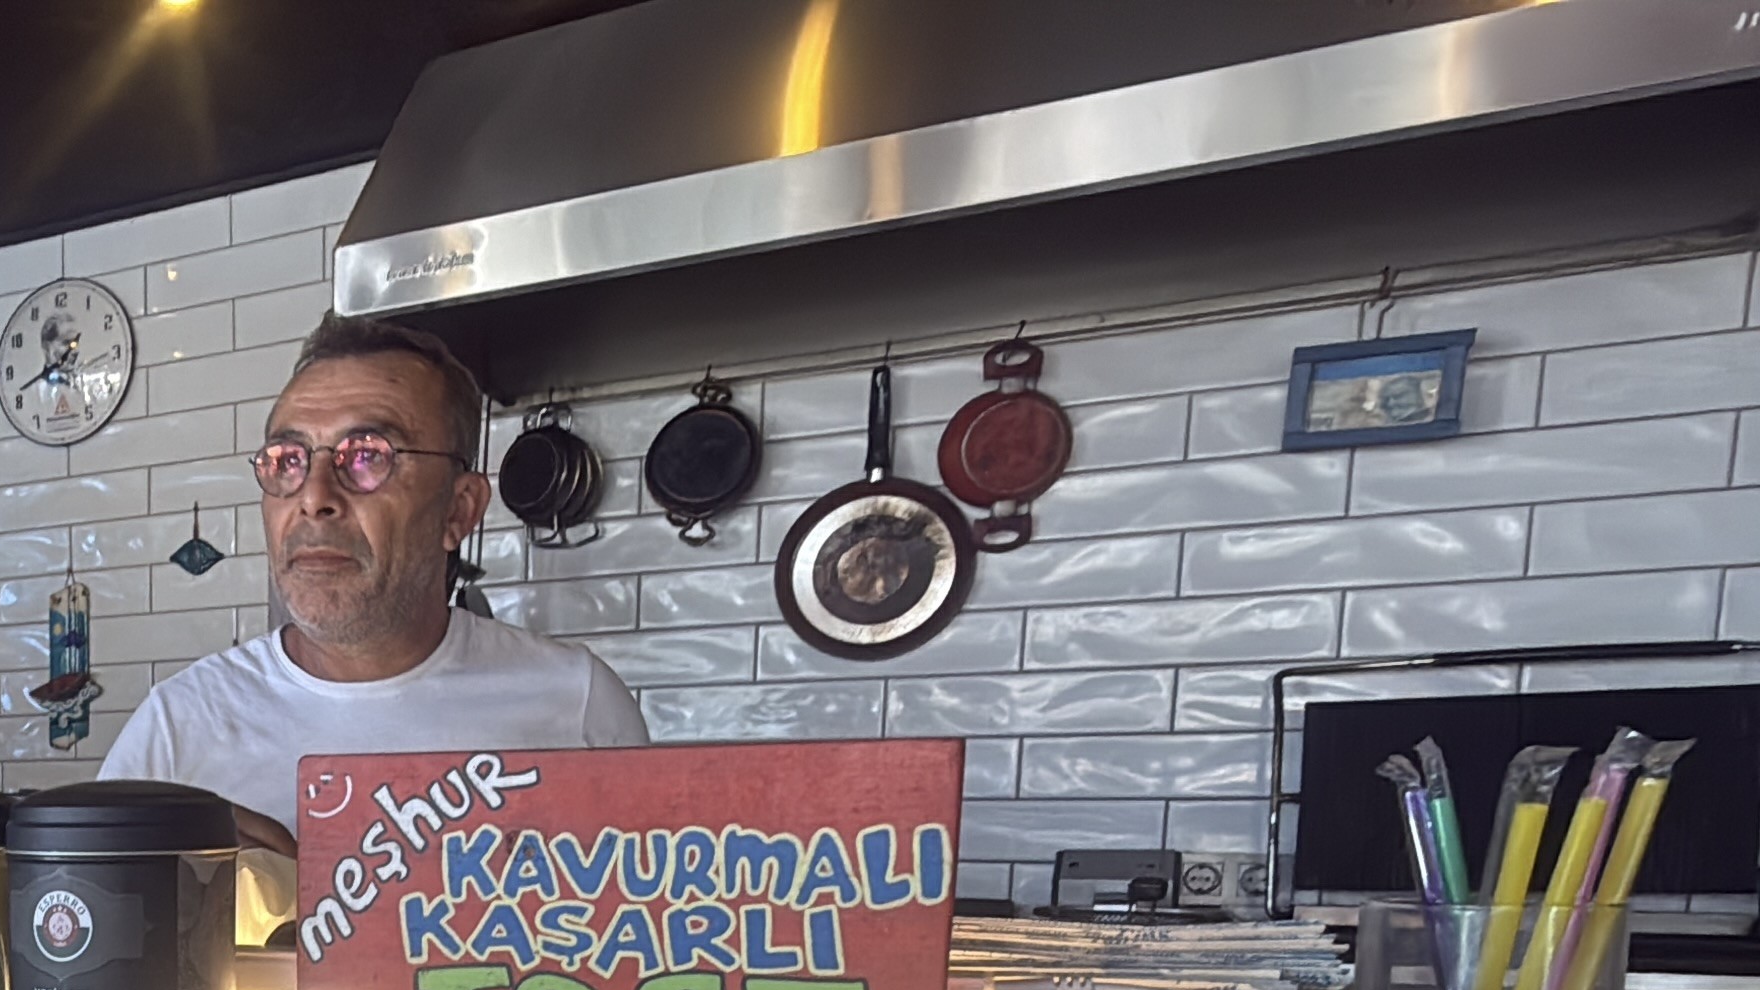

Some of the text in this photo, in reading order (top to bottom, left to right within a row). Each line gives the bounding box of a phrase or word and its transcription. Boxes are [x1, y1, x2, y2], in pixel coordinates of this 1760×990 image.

[55, 292, 68, 308] 12
[104, 314, 113, 331] 2
[11, 333, 23, 348] 10
[112, 344, 121, 361] 3
[5, 365, 14, 381] 9
[15, 395, 23, 410] 8
[84, 404, 94, 421] 5
[32, 414, 41, 430] 7
[38, 893, 86, 916] ESPERRO
[400, 891, 846, 978] KAŞARLI
